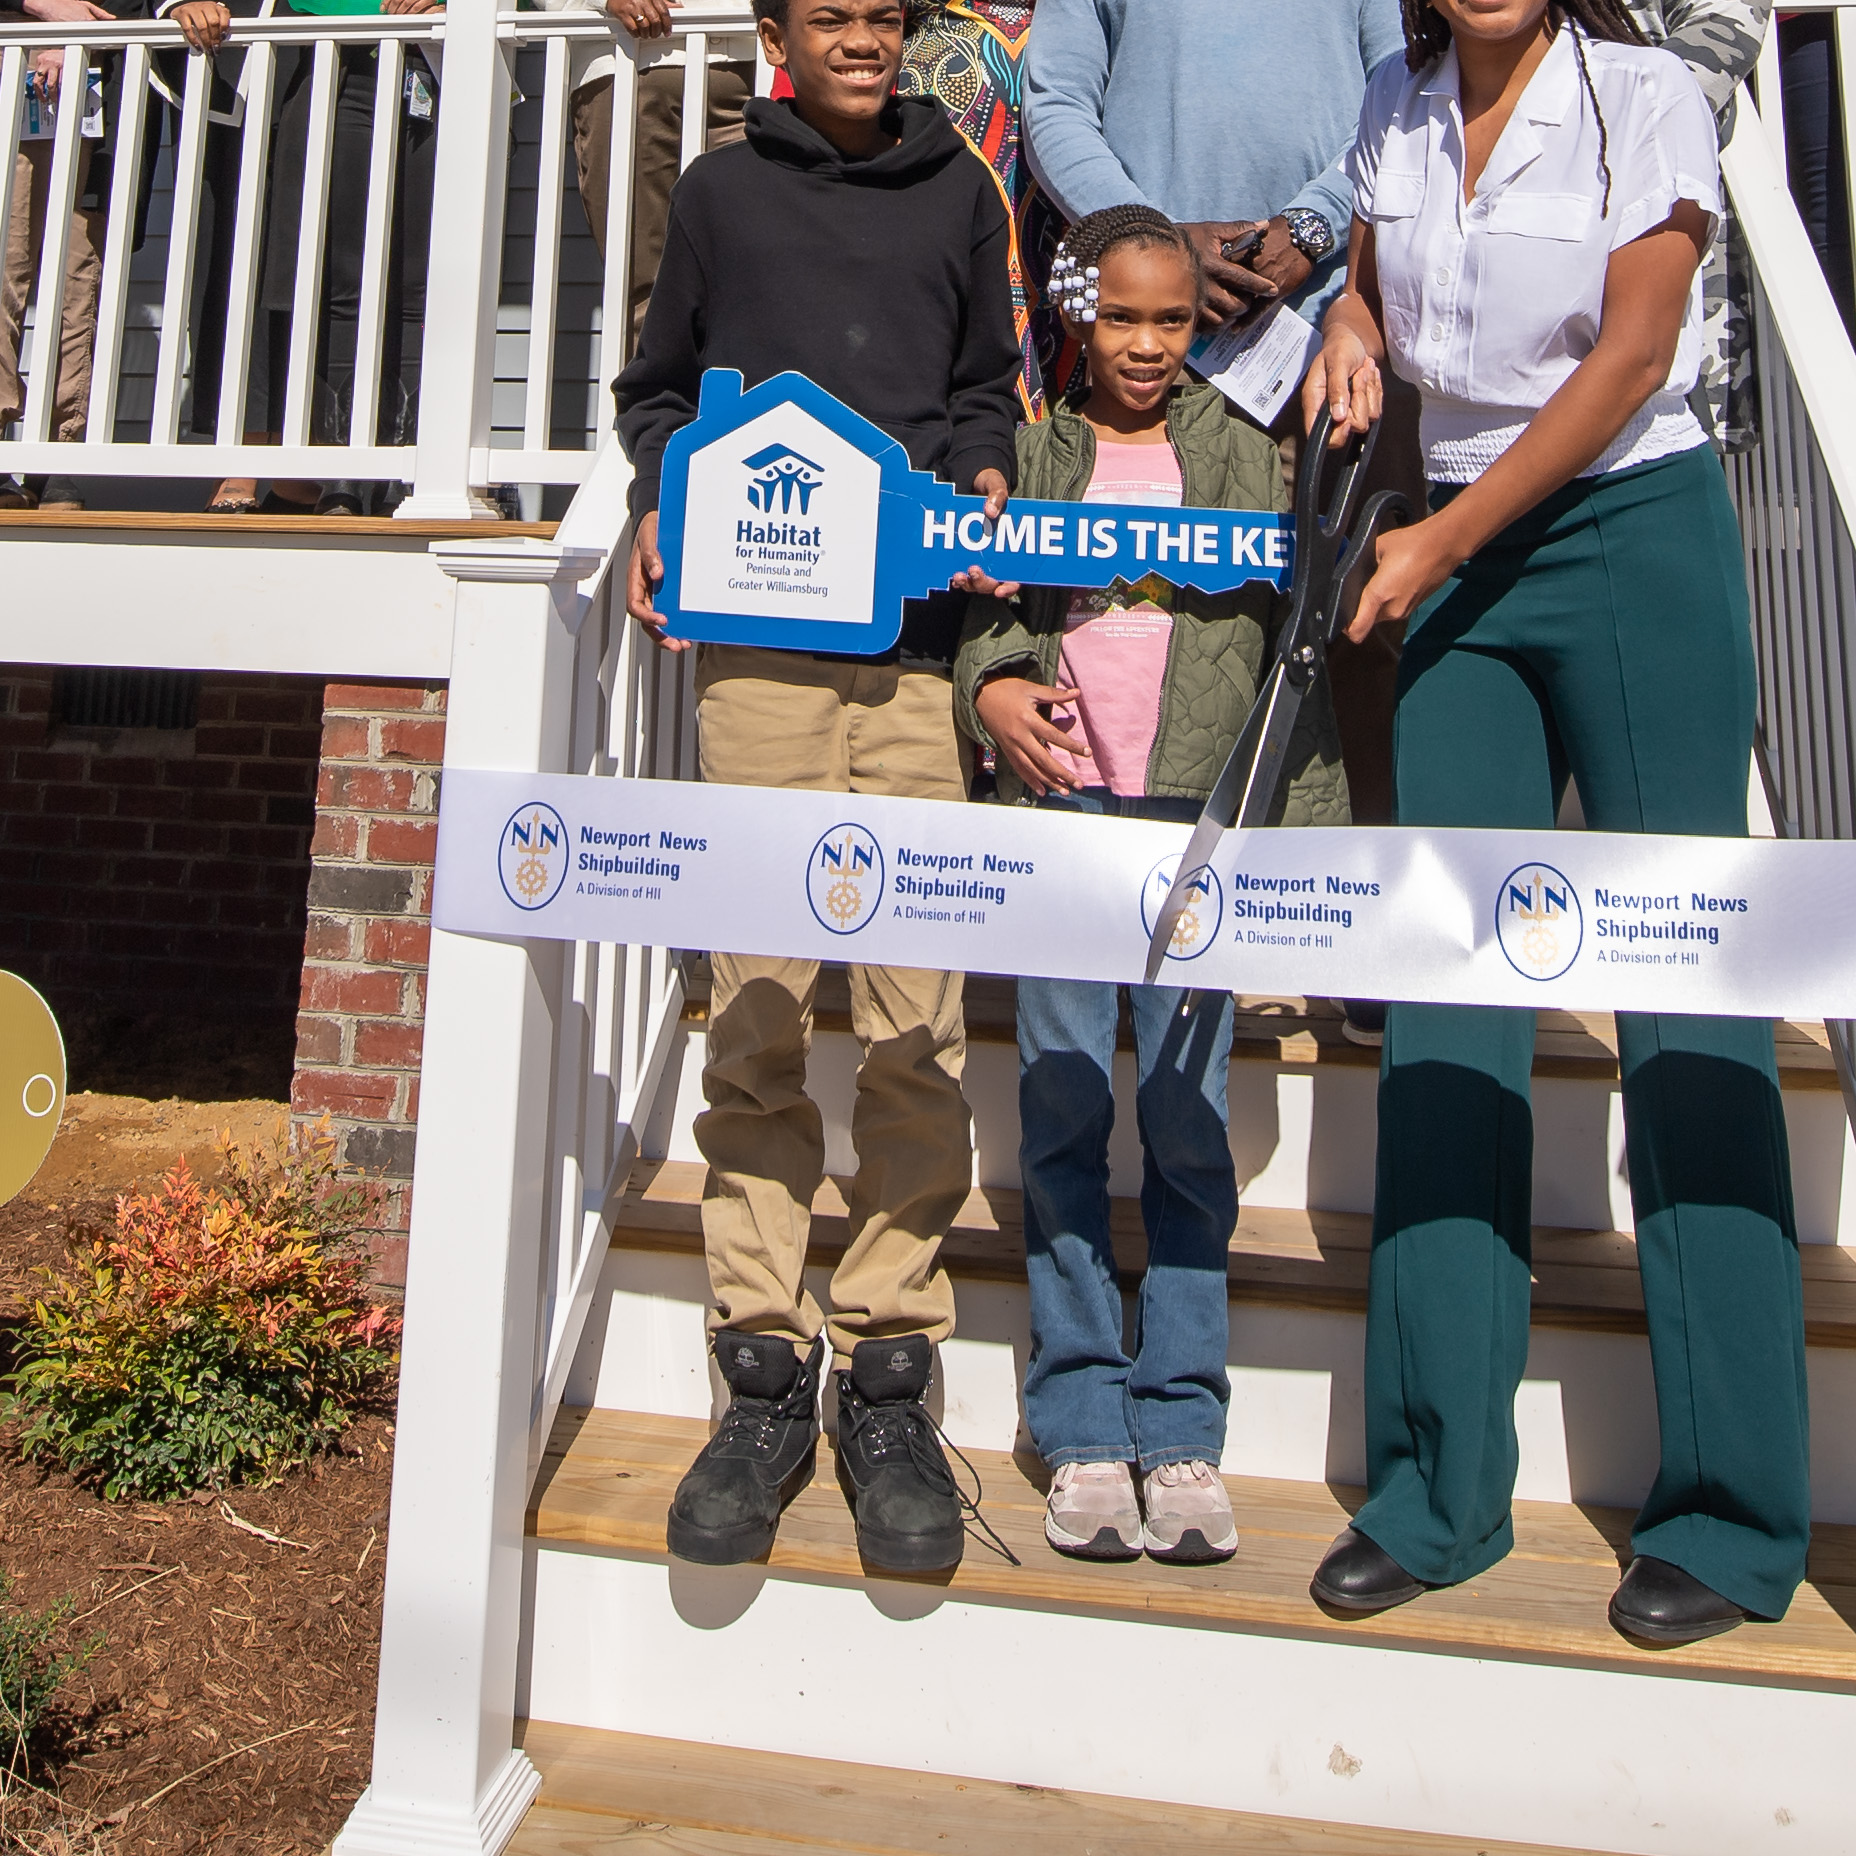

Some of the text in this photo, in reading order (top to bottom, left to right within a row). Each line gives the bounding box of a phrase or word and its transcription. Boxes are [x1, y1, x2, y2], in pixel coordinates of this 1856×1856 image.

[736, 520, 821, 547] Habitat
[922, 509, 1297, 568] HOME IS THE KE
[735, 545, 754, 558] for
[746, 562, 812, 577] Peninsula and
[727, 578, 828, 598] Greater Williamsburg
[580, 826, 708, 852] Newport News
[578, 852, 681, 881] Shipbuilding
[897, 848, 1035, 875] Newport News
[576, 882, 585, 894] A
[587, 883, 629, 898] Division
[632, 886, 644, 899] of
[894, 875, 1006, 906] Shipbuilding
[1235, 874, 1381, 896] Newport News
[1234, 899, 1353, 928] Shipbuilding
[1595, 889, 1749, 914] Newport News
[893, 906, 902, 918] A
[905, 906, 951, 922] Division
[954, 910, 967, 923] of
[1234, 930, 1244, 943] A
[1247, 930, 1295, 946] Division
[1299, 933, 1313, 947] of
[1596, 919, 1720, 945] Shipbuilding
[1597, 950, 1607, 962] A
[1611, 950, 1661, 964] Division
[1665, 952, 1679, 965] of
